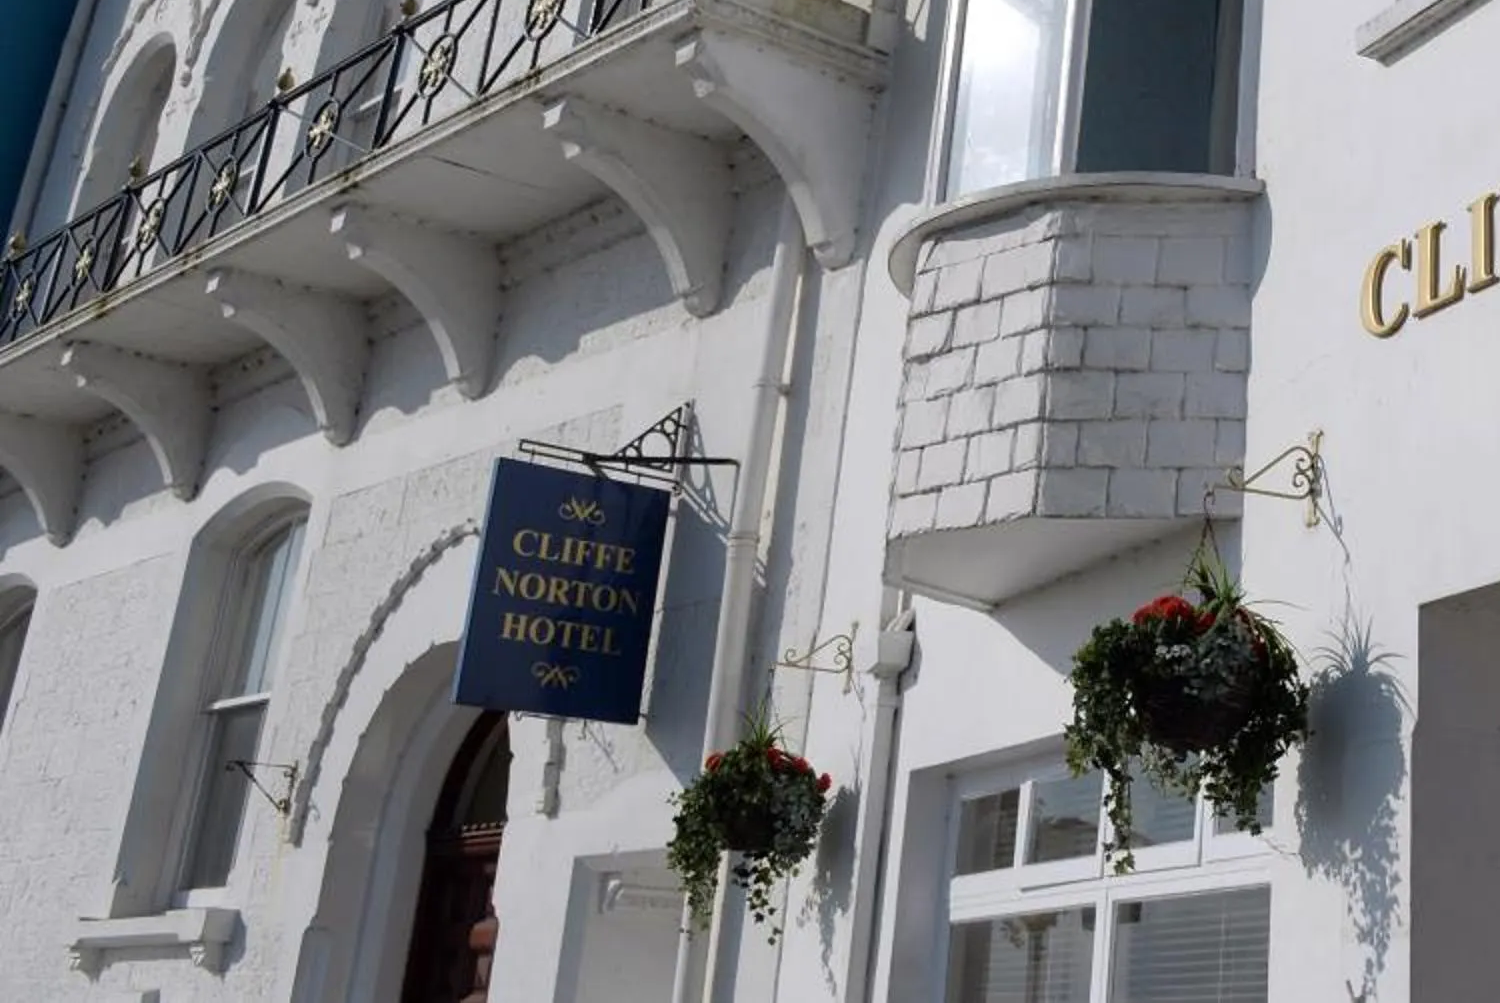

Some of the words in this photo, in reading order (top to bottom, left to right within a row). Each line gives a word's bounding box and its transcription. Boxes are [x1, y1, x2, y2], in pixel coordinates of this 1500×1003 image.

[512, 529, 636, 574] CLIFFE
[493, 567, 641, 617] NORTON
[501, 612, 621, 656] HOTEL
